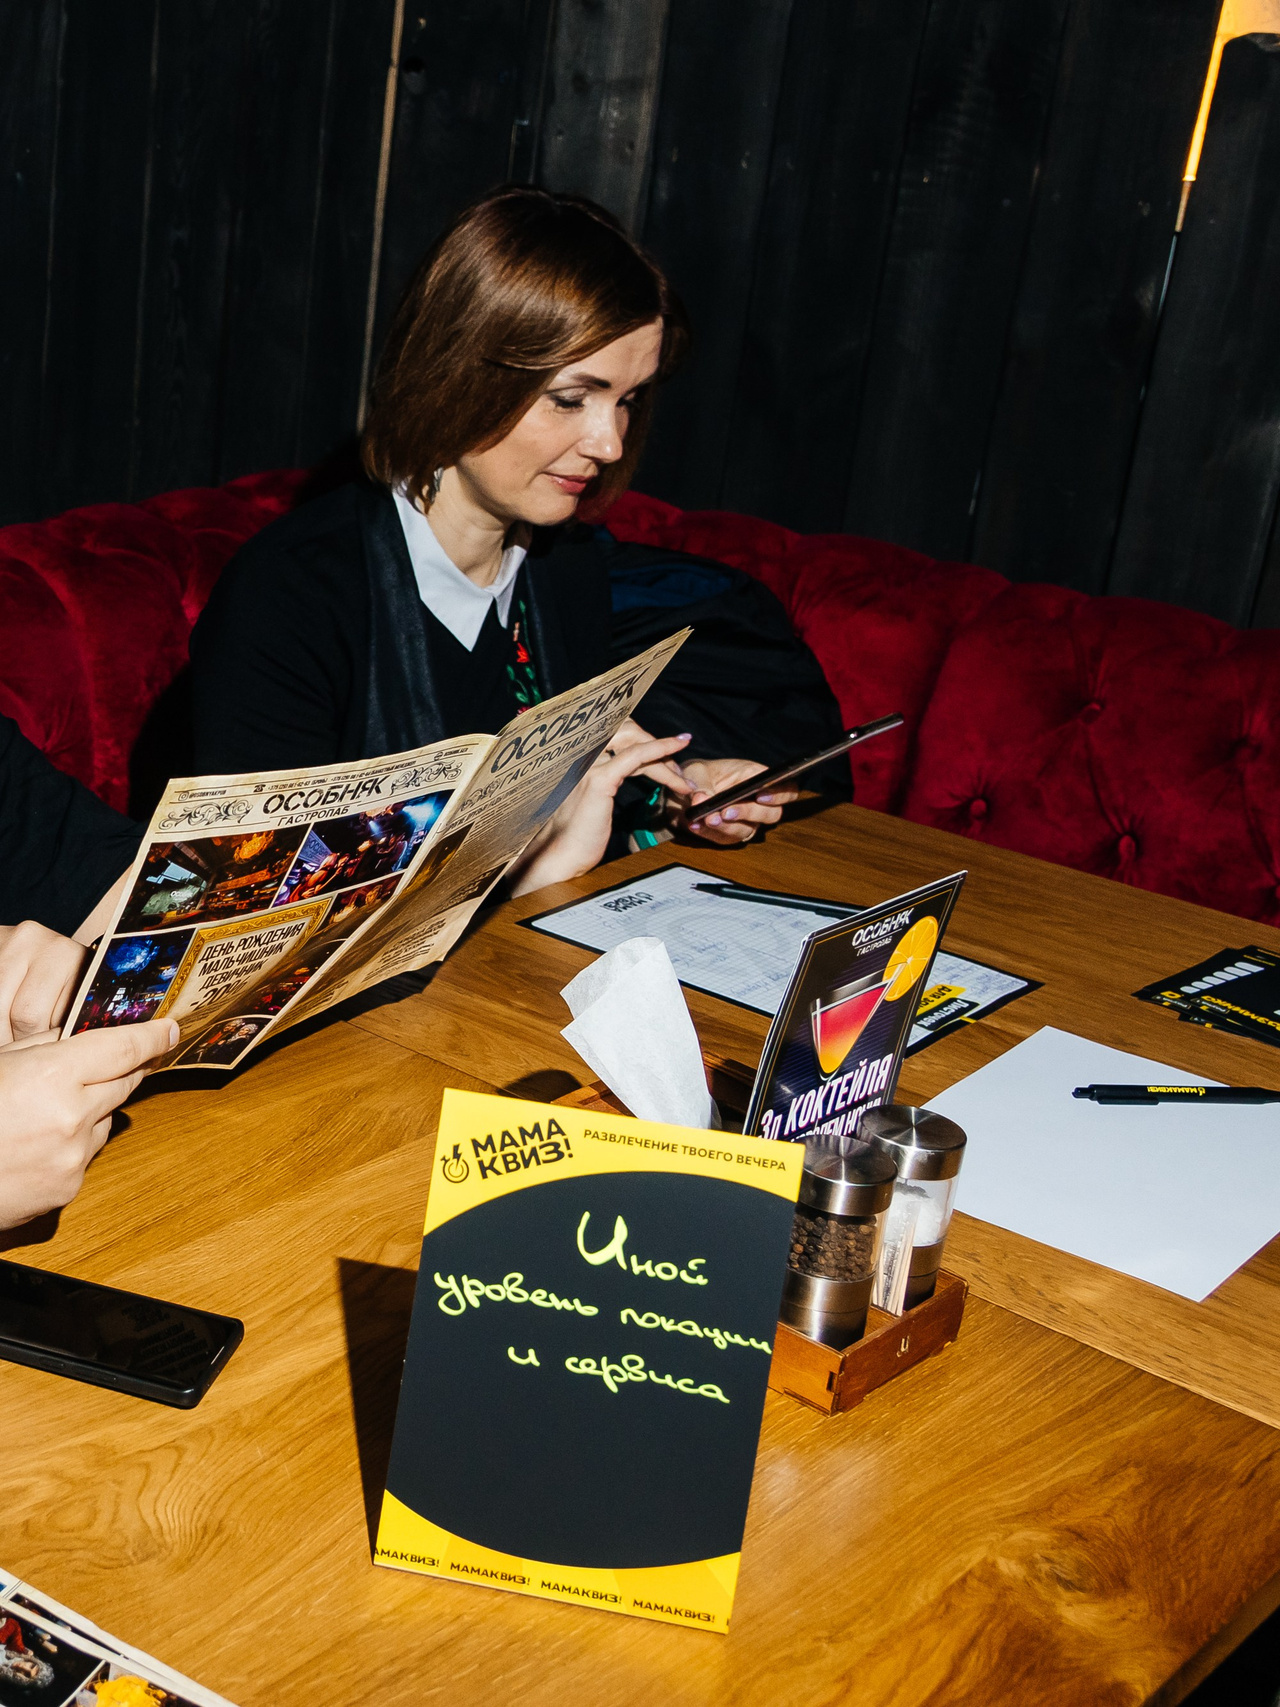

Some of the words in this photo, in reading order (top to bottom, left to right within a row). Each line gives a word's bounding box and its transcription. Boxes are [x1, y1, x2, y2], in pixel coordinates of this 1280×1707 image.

[490, 665, 652, 774] ОСОБНЯК
[498, 729, 589, 790] ГАСТРОПАБ
[262, 775, 391, 815] ОСОБНЯК
[277, 804, 349, 826] ГАСТРОПАБ
[199, 941, 236, 963] ДЕНЬ
[234, 922, 306, 952] РОЖДЕНИЯ
[851, 907, 915, 947] ОСОБНЯК
[198, 940, 289, 977] МАЛЬЧИШНИК
[199, 959, 269, 991] ДЕВИЧНИК
[783, 1053, 894, 1136] КОКТЕЙЛЯ
[470, 1118, 567, 1159] МАМА
[477, 1138, 573, 1180] КВИЗ!
[584, 1129, 678, 1153] РАЗВЛЕЧЕНИЕ
[681, 1145, 733, 1162] ТВОЕГО
[736, 1154, 787, 1172] ВЕЧЕРА
[576, 1211, 709, 1286] Иной
[433, 1272, 600, 1317] уровень
[507, 1345, 541, 1367] и
[564, 1353, 731, 1404] сервиса
[450, 1562, 531, 1586] МАМАКВИЗ!
[541, 1580, 622, 1605] МАМАКВИЗ!
[633, 1598, 716, 1623] МАМАКВИЗ!
